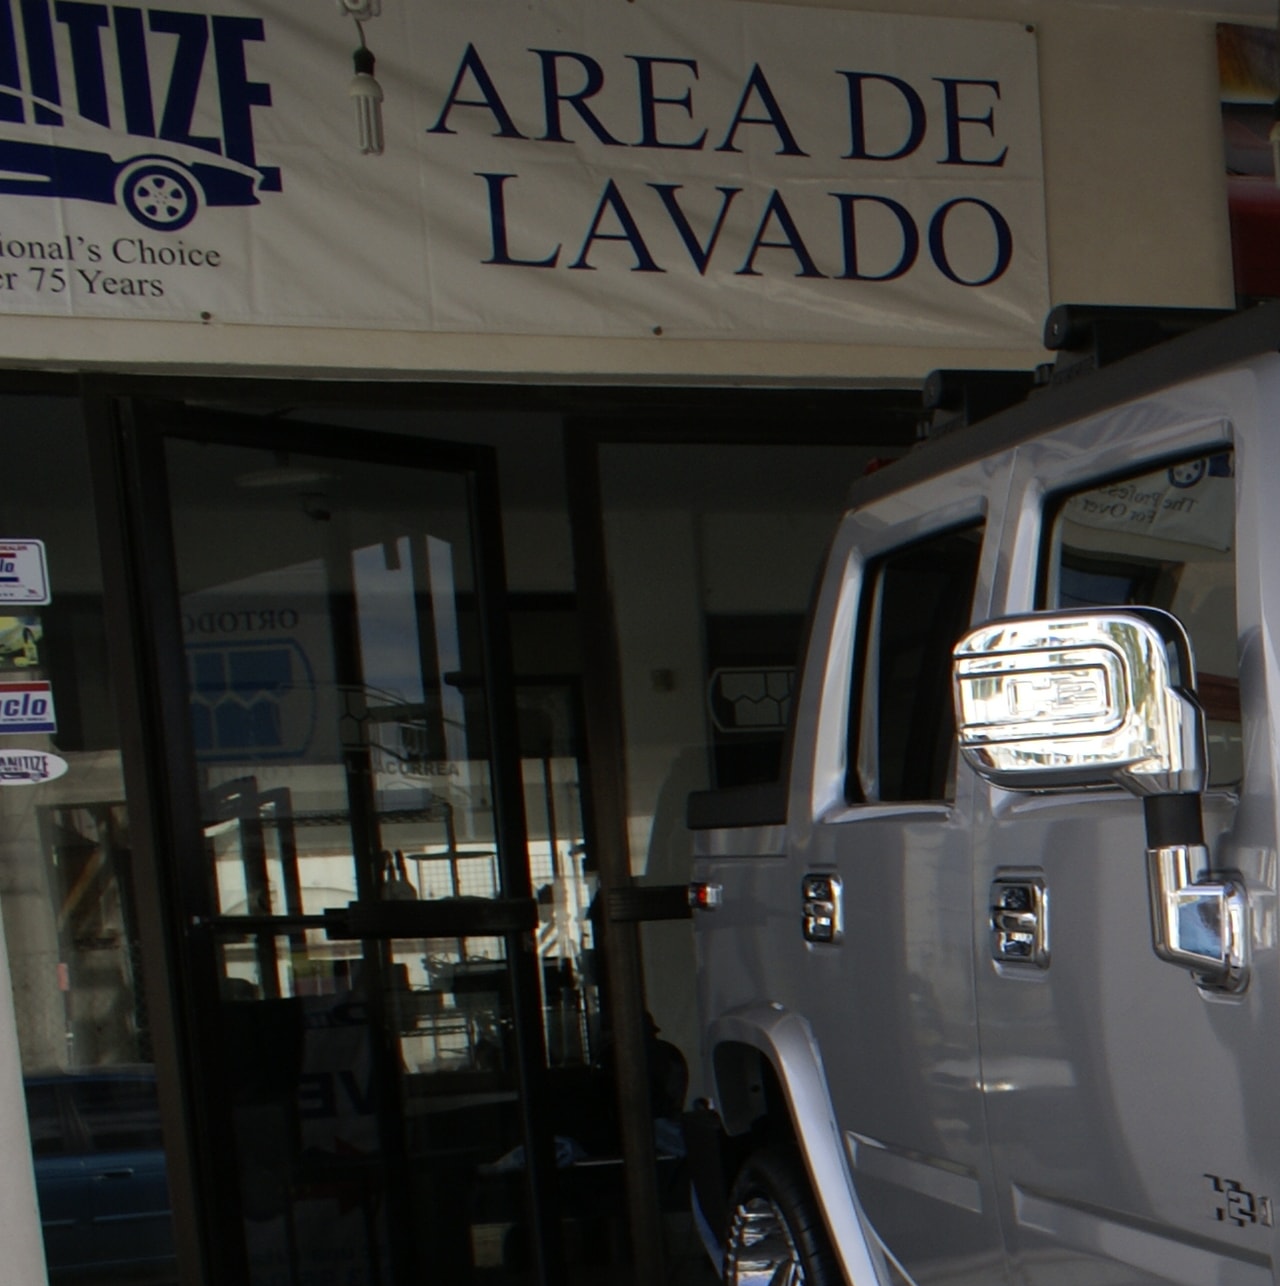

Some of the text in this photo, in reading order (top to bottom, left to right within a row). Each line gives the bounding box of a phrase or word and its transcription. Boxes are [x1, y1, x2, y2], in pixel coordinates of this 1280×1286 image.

[426, 42, 1008, 167] AREA DE
[474, 172, 1012, 286] LAVADO
[113, 238, 221, 267] Choice
[0, 267, 164, 297] r 75 Years
[0, 693, 47, 716] clo
